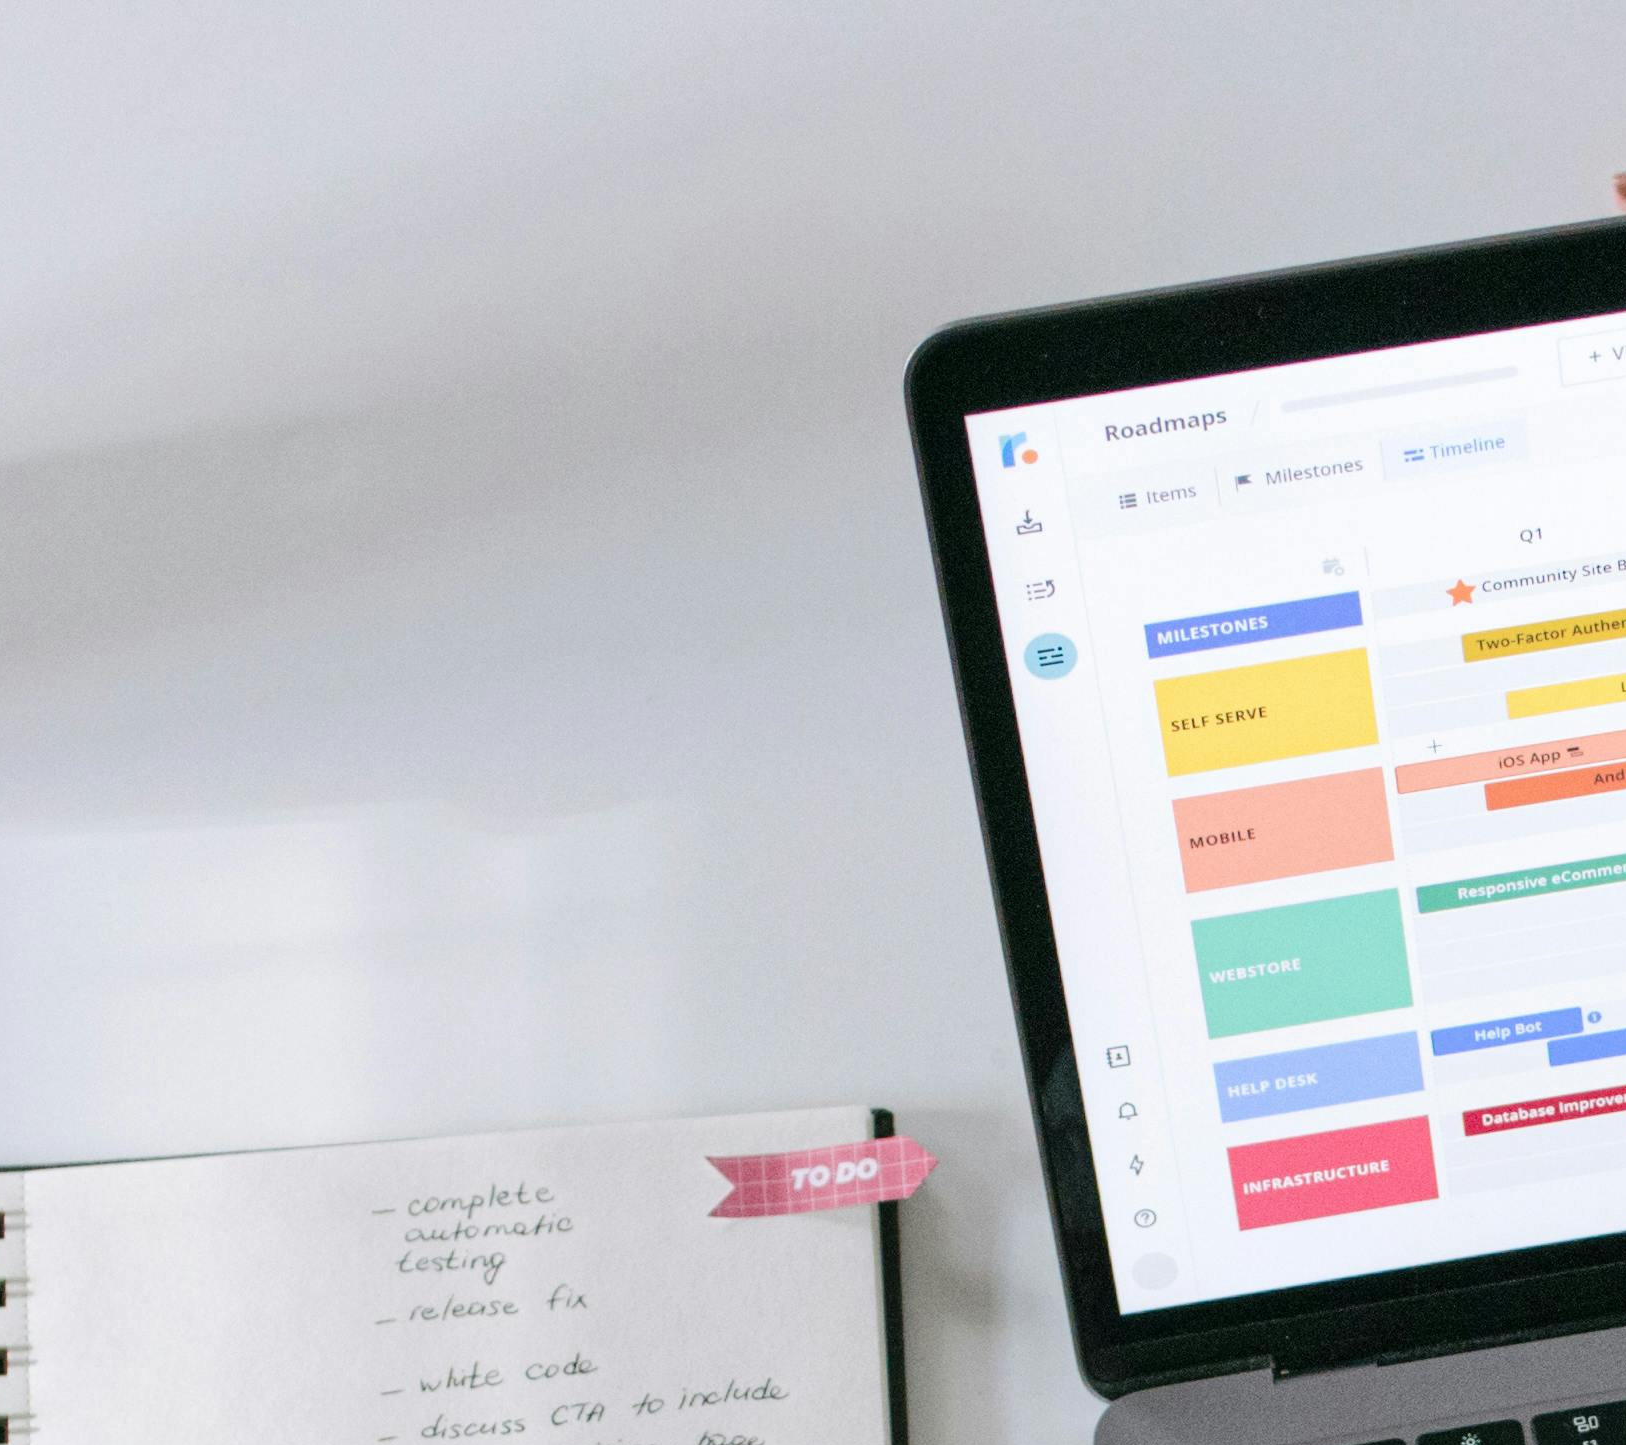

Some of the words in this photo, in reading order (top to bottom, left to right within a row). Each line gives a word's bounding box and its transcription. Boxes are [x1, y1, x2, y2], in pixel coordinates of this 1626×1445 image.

[1104, 408, 1227, 443] Roadmaps
[1429, 435, 1505, 459] Timeline
[1266, 457, 1364, 487] Milestones
[1146, 483, 1197, 504] Items
[1520, 527, 1543, 543] Q1
[1482, 567, 1577, 594] Community
[1582, 560, 1612, 577] Site
[1157, 616, 1269, 646] MILESTONES
[1476, 627, 1567, 652] Two-Factor
[1171, 716, 1210, 733] SELF
[1215, 706, 1269, 726] SERVE
[1498, 751, 1529, 768] iOS
[1532, 749, 1561, 767] App
[1190, 828, 1256, 849] MOBILE
[1458, 872, 1547, 900] Responsive
[1209, 959, 1302, 984] WEBSTORE
[1474, 1025, 1511, 1043] Help
[1514, 1019, 1543, 1035] Bot
[1227, 1081, 1270, 1098] HELP
[1274, 1073, 1319, 1091] DESK
[1482, 1105, 1555, 1127] Database
[791, 1166, 829, 1190] TO
[835, 1157, 879, 1185] DO
[1243, 1159, 1390, 1195] INFRASTRUCTURE
[407, 1183, 557, 1220] complete
[404, 1215, 573, 1243] automatic
[395, 1248, 508, 1284] testing
[409, 1294, 520, 1322] release
[547, 1284, 589, 1311] fix
[525, 1353, 600, 1382] code
[420, 1415, 527, 1441] discuss
[550, 1401, 606, 1427] CTA
[632, 1393, 665, 1415] to
[678, 1377, 791, 1410] include
